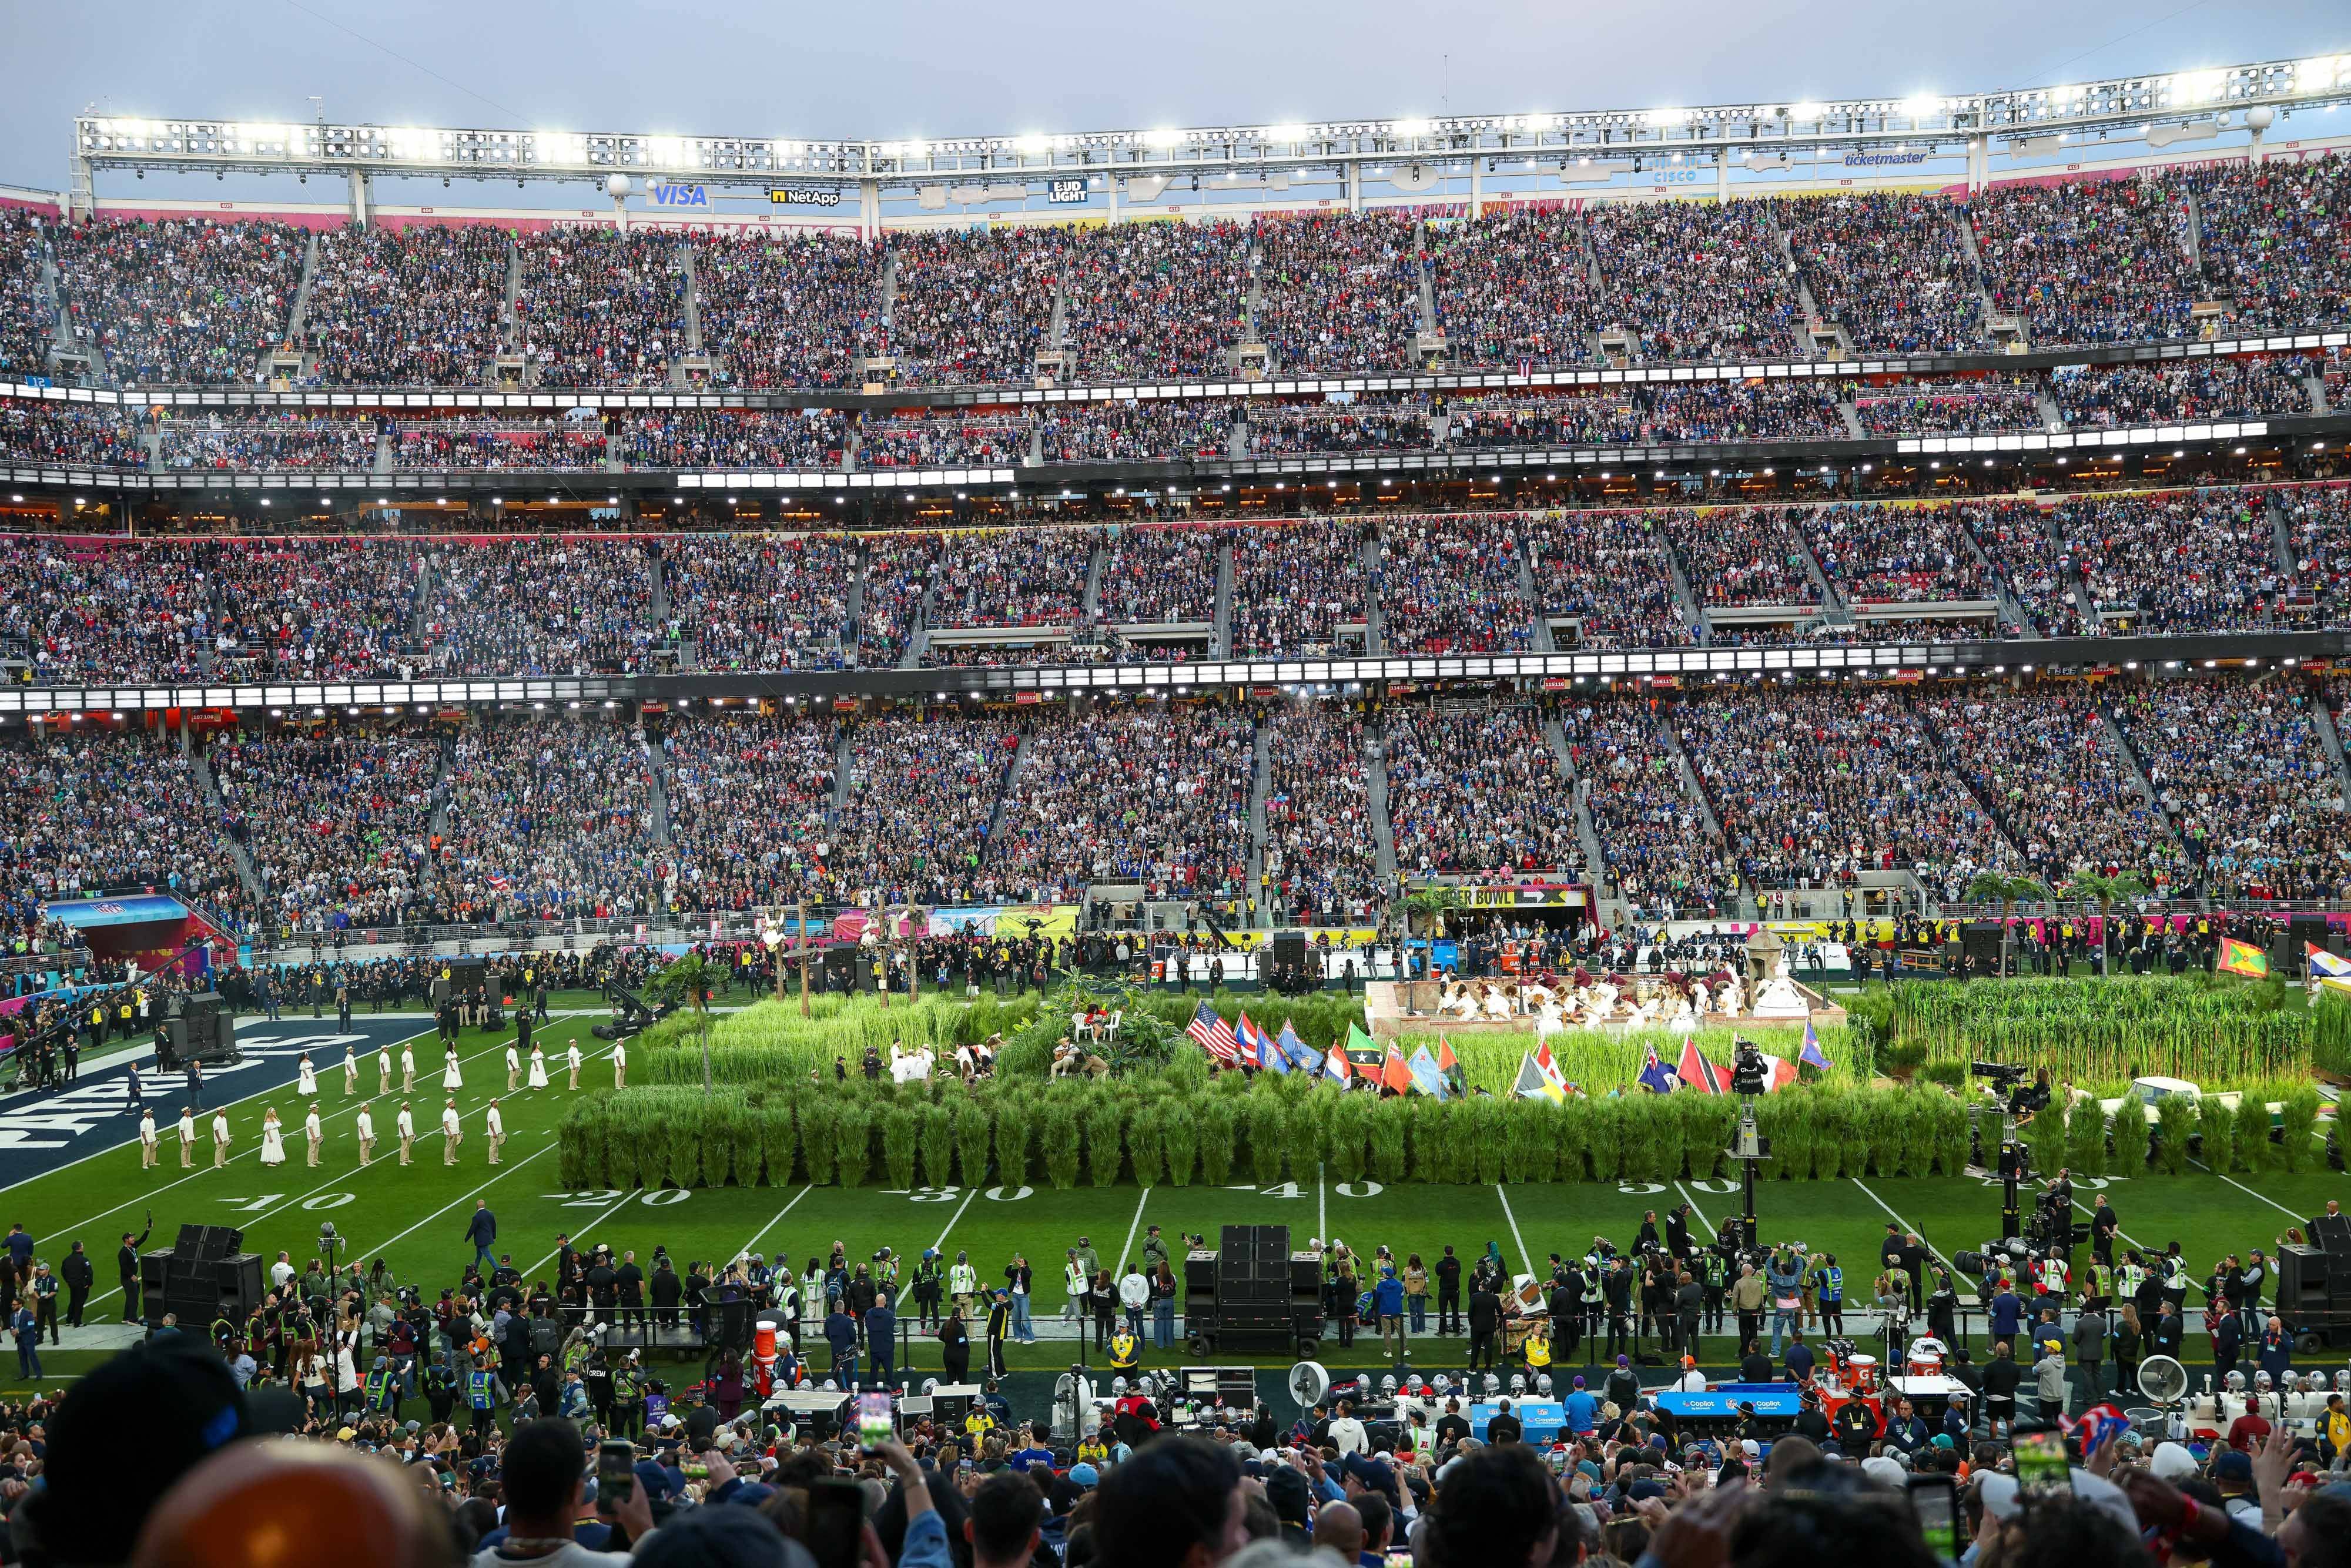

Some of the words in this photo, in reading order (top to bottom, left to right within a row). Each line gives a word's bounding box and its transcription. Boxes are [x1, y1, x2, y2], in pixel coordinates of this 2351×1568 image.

[1844, 151, 1928, 166] ticketmaster
[1654, 170, 1696, 182] CISCO
[1054, 181, 1081, 192] BUD
[654, 185, 706, 205] VISA
[788, 191, 839, 206] NetApp
[1049, 190, 1087, 202] LIGHT
[1481, 201, 1526, 221] SUPER
[1529, 199, 1565, 215] BOWL
[34, 377, 46, 387] 12
[1476, 890, 1511, 904] BOWL
[1514, 888, 1566, 904] LX
[1260, 1180, 1384, 1198] 40
[1617, 1177, 1742, 1193] 50
[560, 1188, 691, 1207] 20
[909, 1185, 1034, 1202] 30
[230, 1193, 356, 1210] 10
[1667, 1214, 1676, 1224] CREW
[753, 1364, 760, 1384] G
[1859, 1369, 1869, 1380] G
[1335, 1386, 1354, 1395] PREGAME
[1122, 1448, 1131, 1458] CSC
